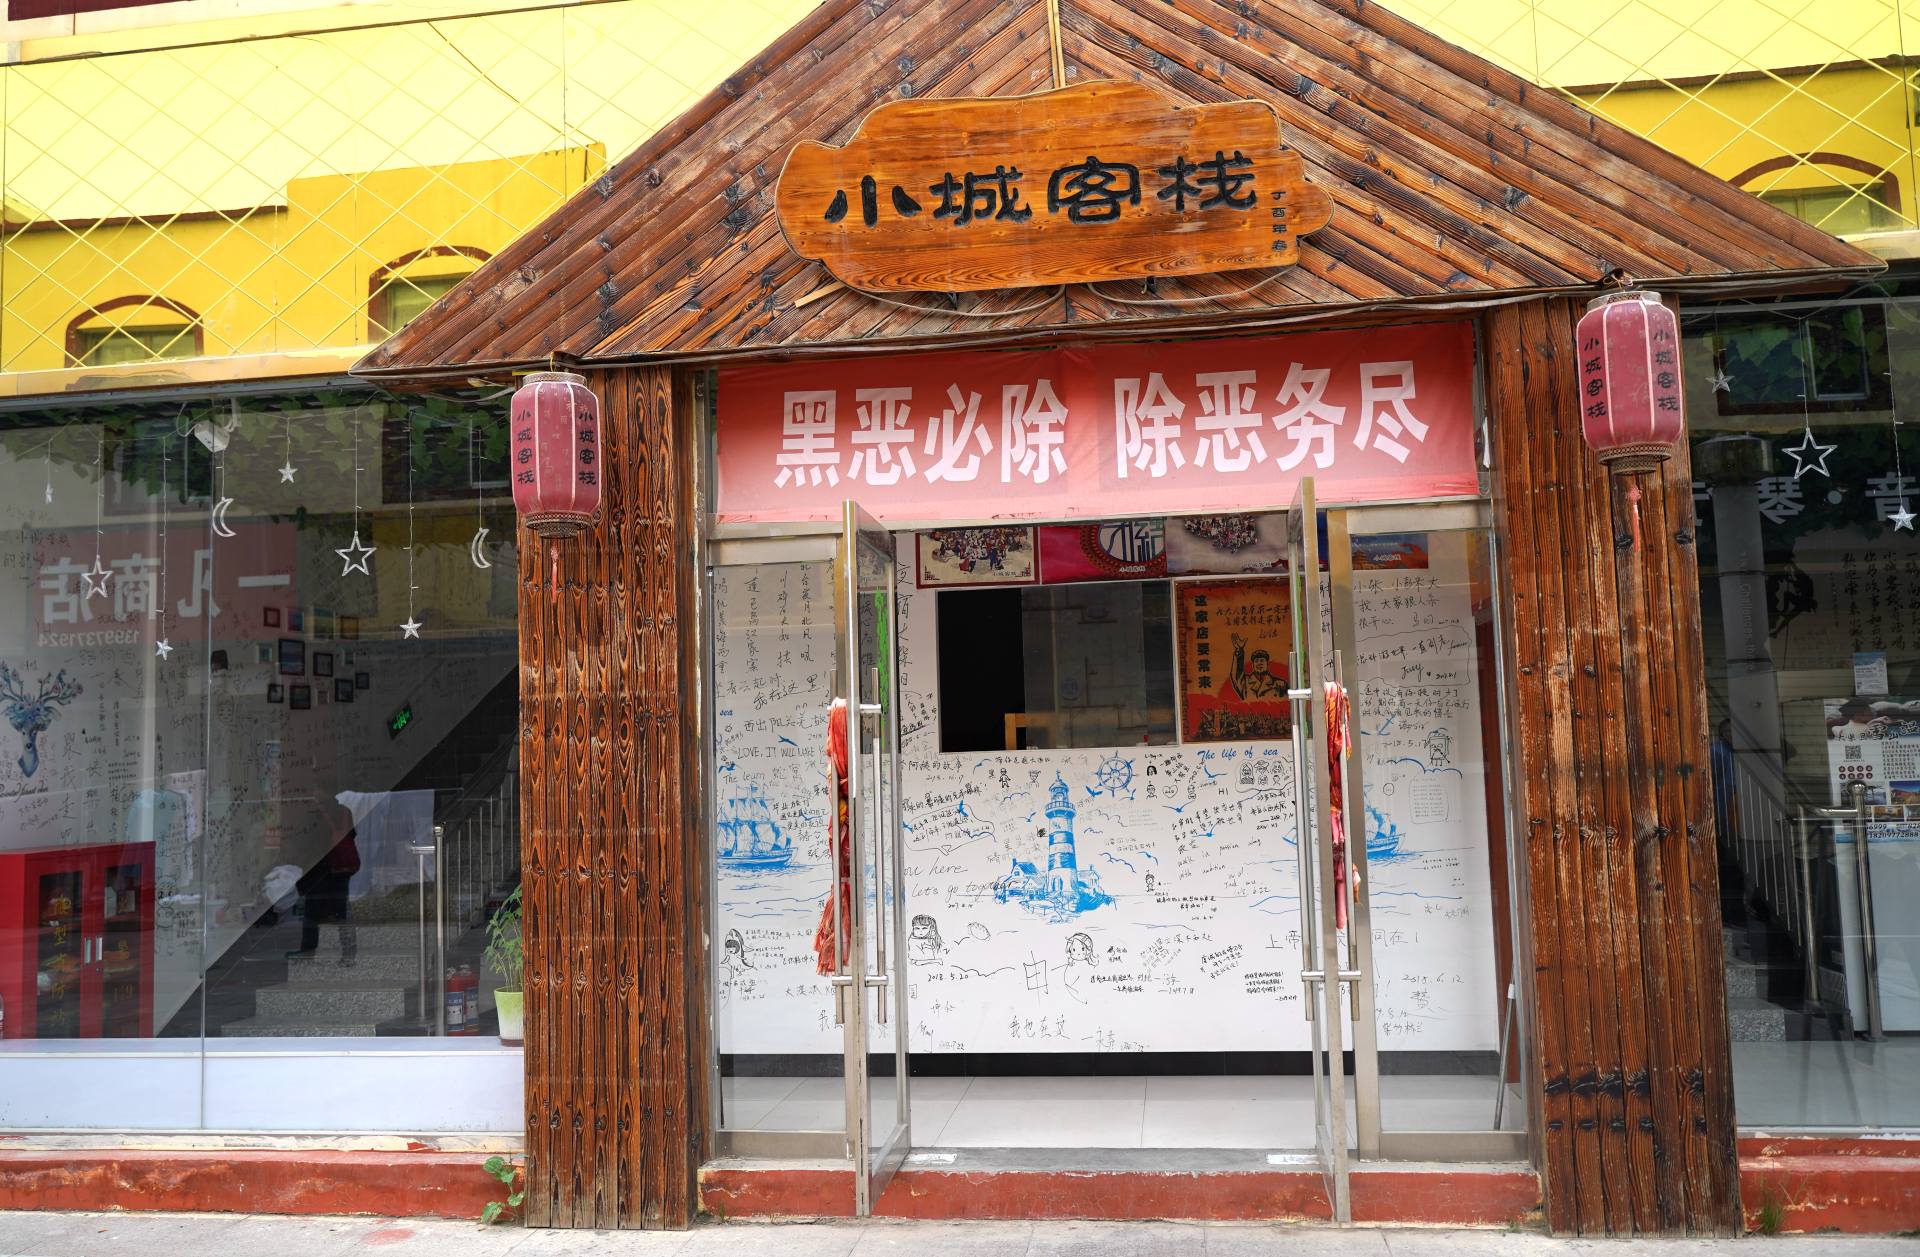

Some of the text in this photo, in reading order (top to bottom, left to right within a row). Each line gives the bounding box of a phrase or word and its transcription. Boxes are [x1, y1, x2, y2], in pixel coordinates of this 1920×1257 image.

[824, 149, 1257, 228] 小城客栈
[1584, 338, 1607, 418] 小城客栈
[1653, 331, 1679, 411] 小城客栈
[516, 409, 535, 485] 小城客栈
[577, 411, 597, 486] 小城客栈
[774, 360, 1430, 488] 黑恶必除 除恶务尽
[1194, 594, 1212, 688] 这家店要常来
[1196, 745, 1279, 762] The life of sea
